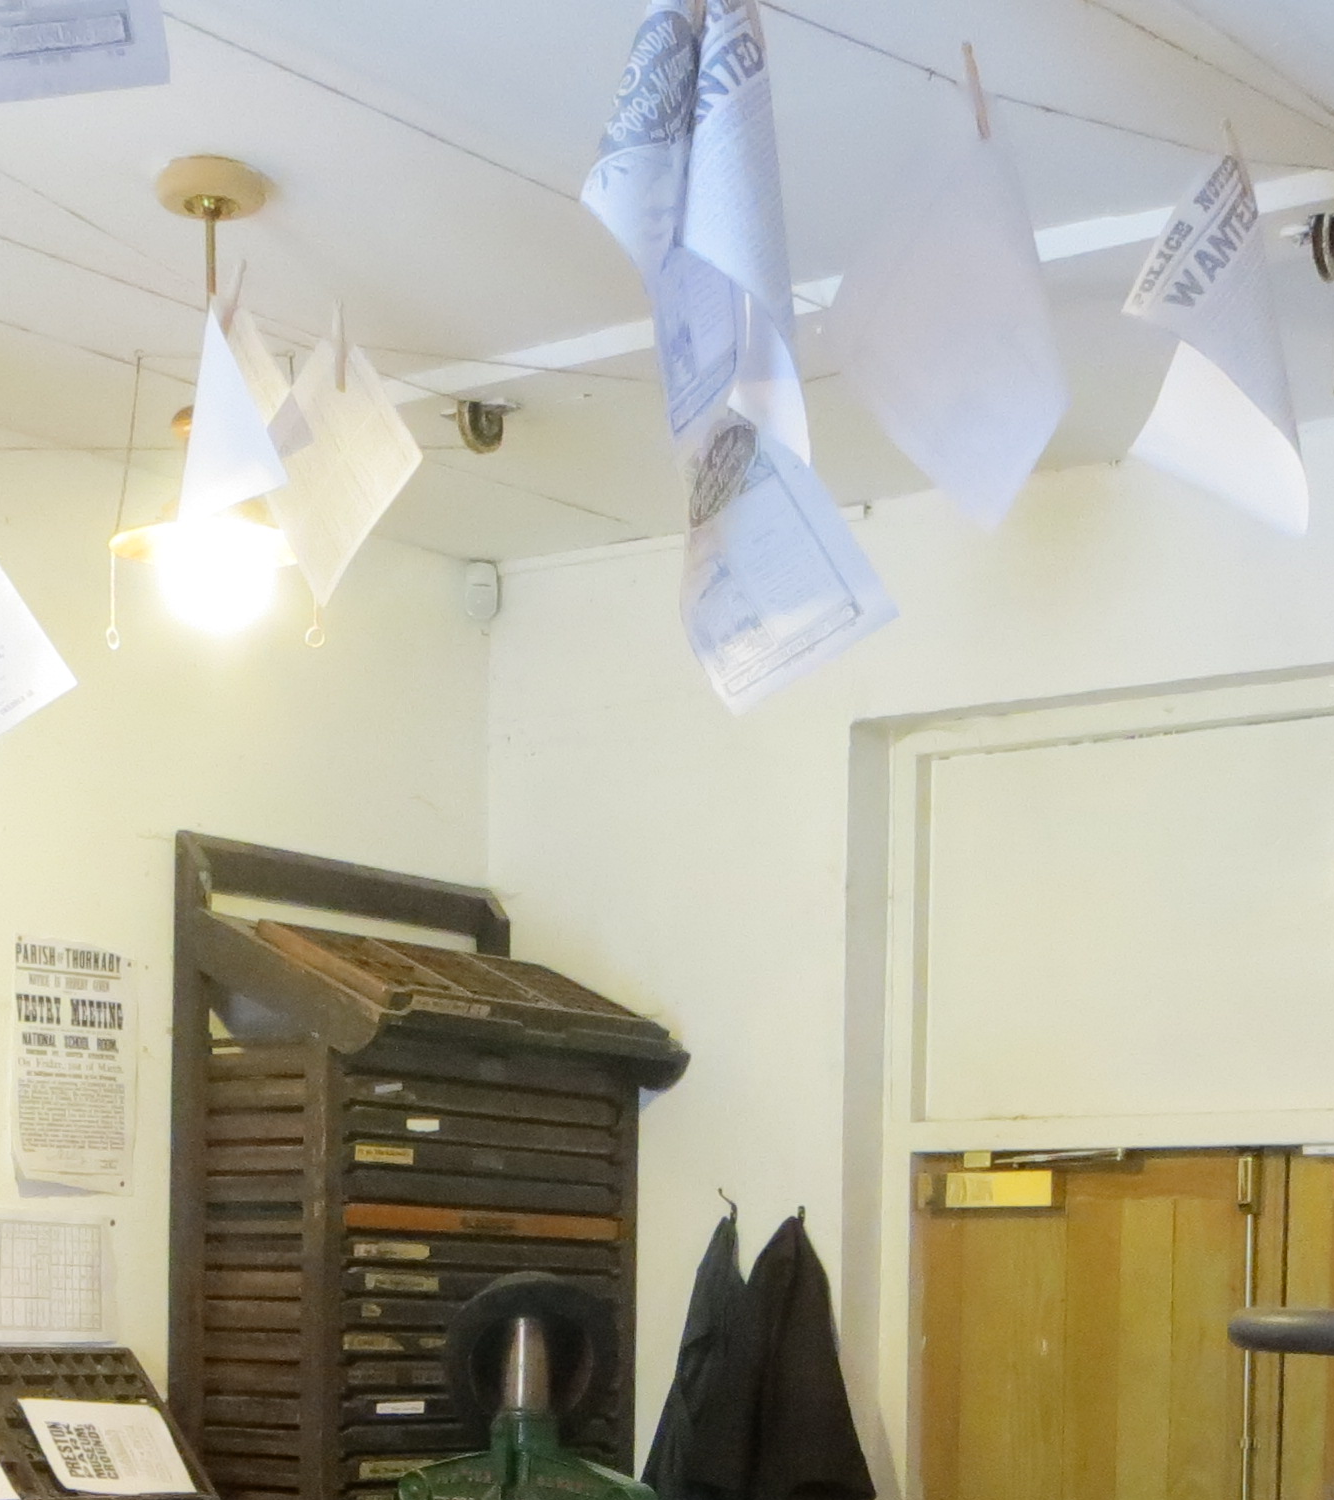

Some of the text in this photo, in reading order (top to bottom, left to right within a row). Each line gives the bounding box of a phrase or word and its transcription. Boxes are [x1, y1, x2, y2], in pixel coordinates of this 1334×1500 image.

[15, 943, 56, 966] PARISH
[64, 947, 122, 973] THORNABY
[15, 993, 123, 1031] VESTRY MEETING
[45, 1421, 85, 1478] PRESTON
[87, 1423, 119, 1480] GROUNDS
